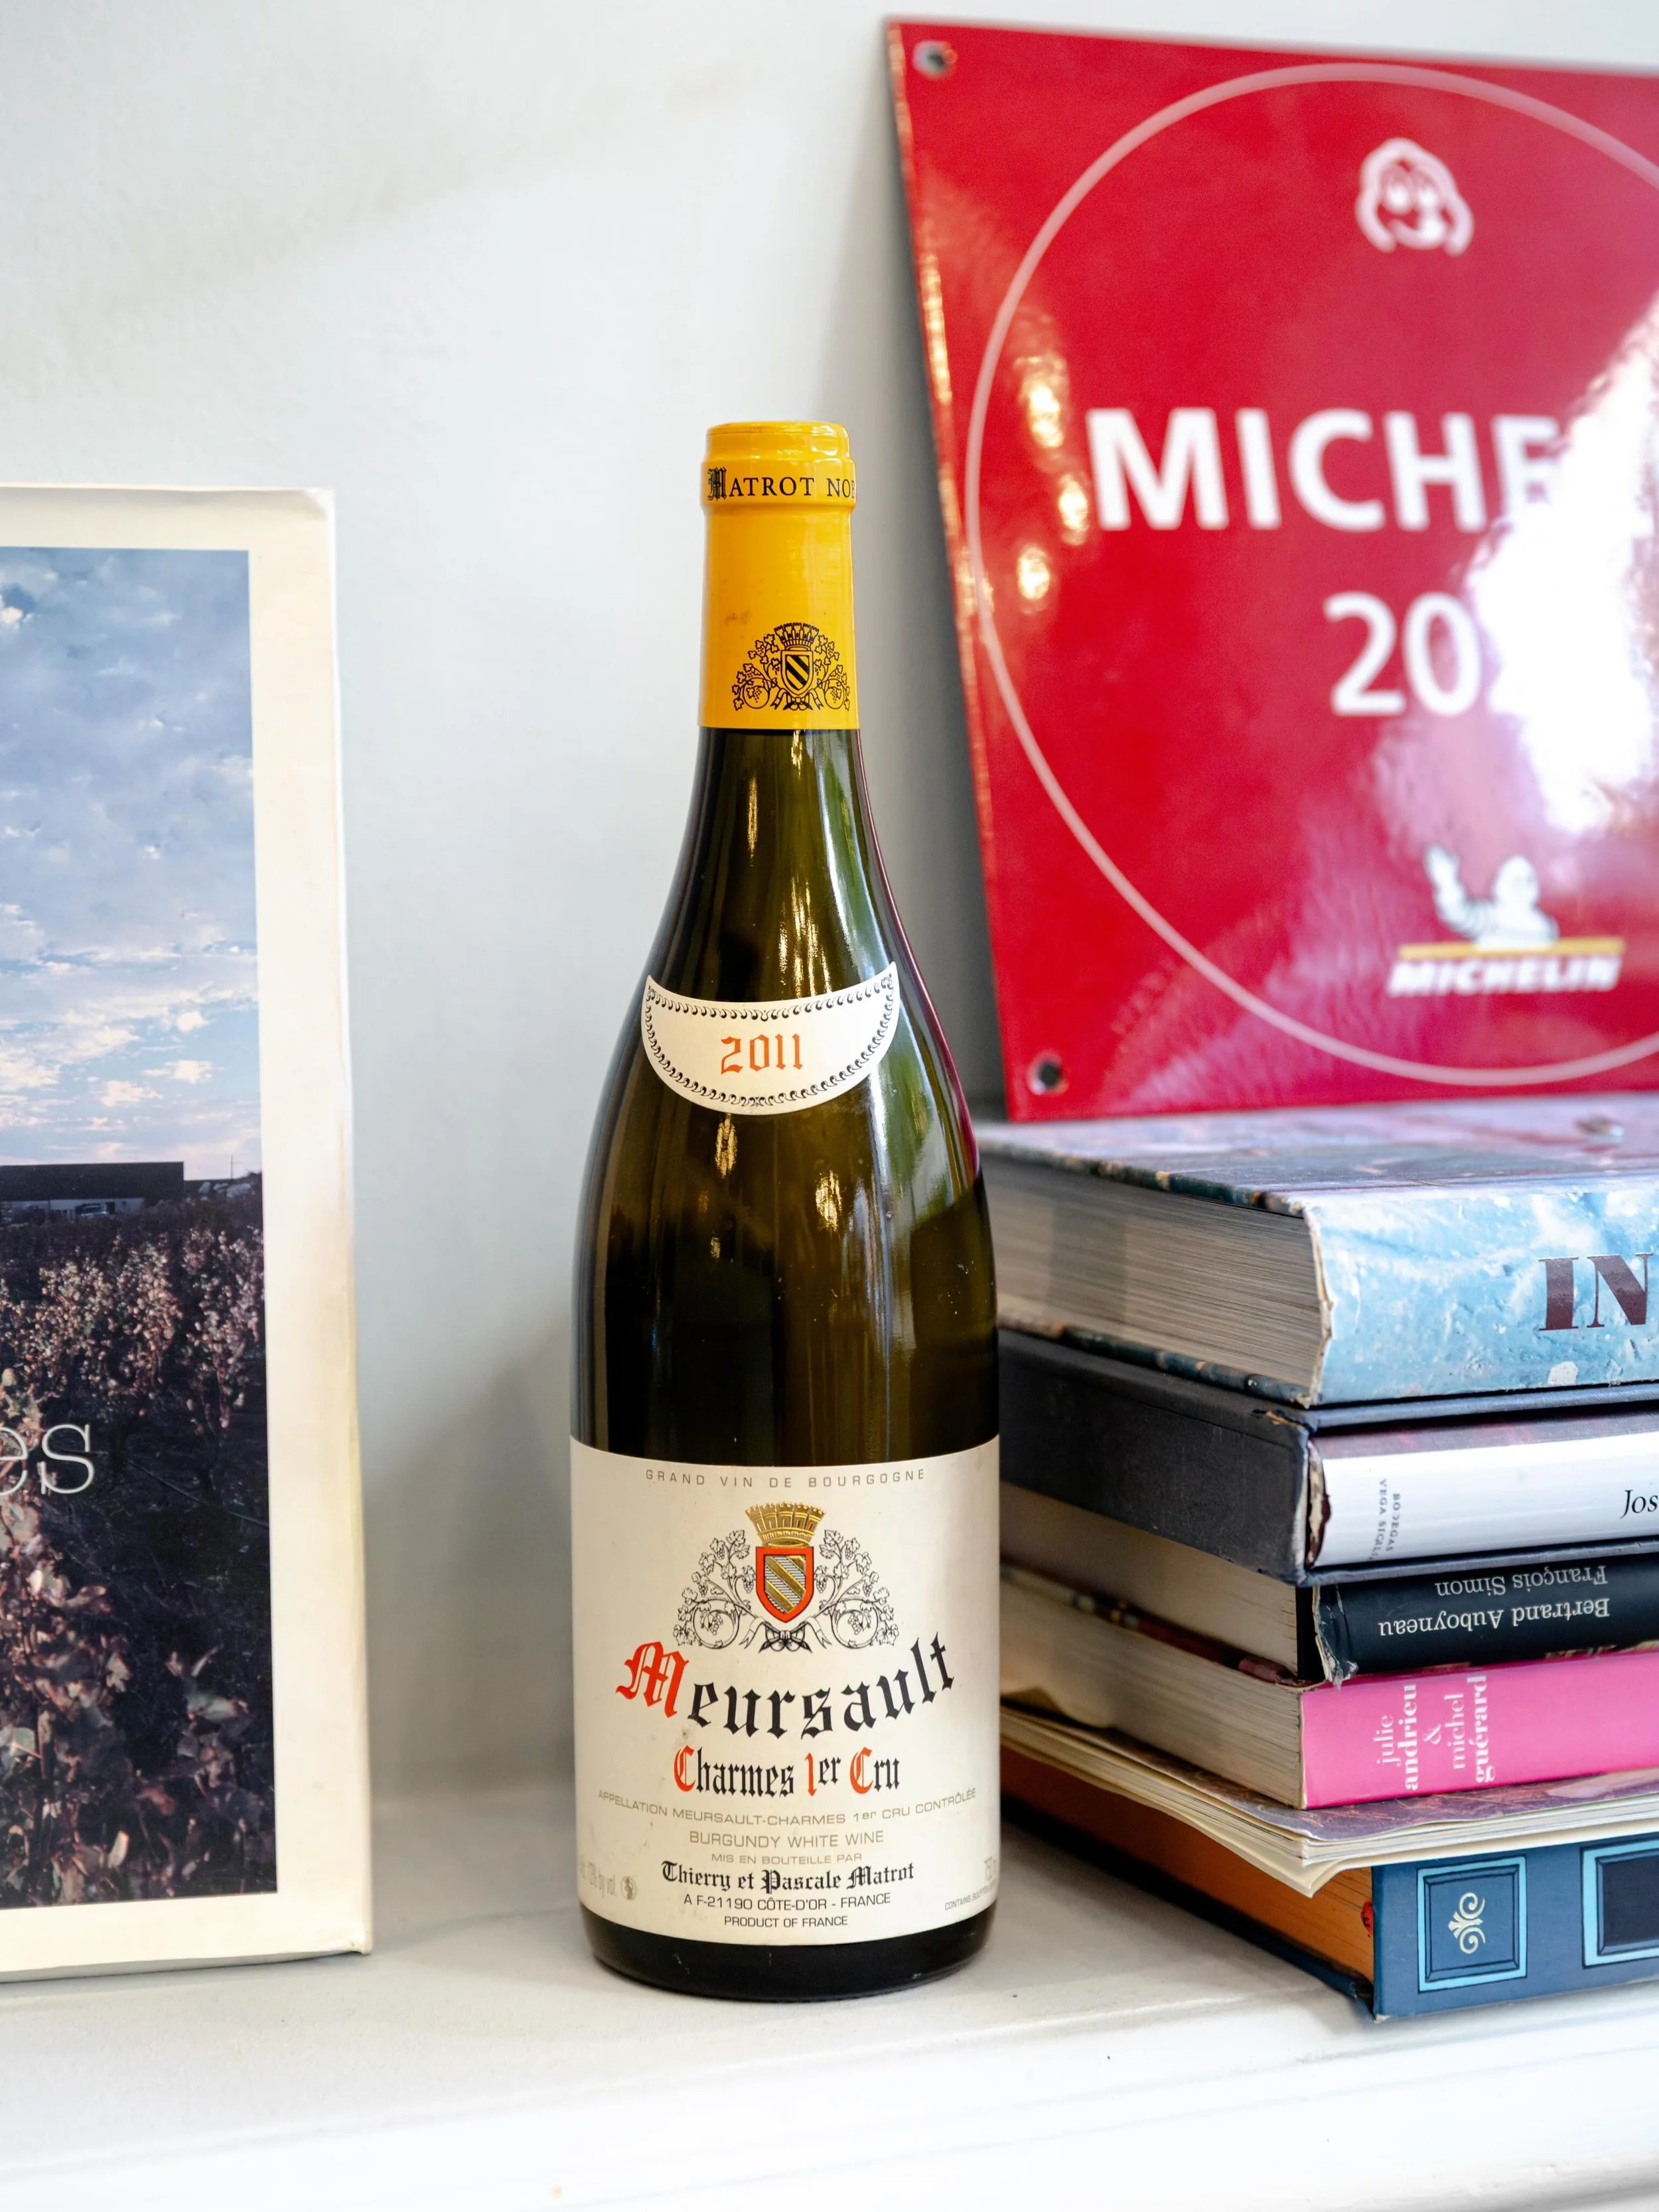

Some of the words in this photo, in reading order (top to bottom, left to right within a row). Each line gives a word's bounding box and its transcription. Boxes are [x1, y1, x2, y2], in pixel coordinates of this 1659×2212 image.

[707, 467, 814, 501] MATROT
[1086, 406, 1561, 531] MICHE
[1324, 591, 1482, 715] 20
[1389, 956, 1621, 996] MICHELIN
[721, 1033, 803, 1074] 2011
[1538, 1252, 1654, 1331] IN
[645, 1469, 705, 1485] GRAND
[721, 1477, 753, 1488] VIN
[769, 1477, 793, 1488] DE
[808, 1469, 926, 1488] BOURGOGNE
[1379, 1478, 1388, 1515] VEGA
[1619, 1489, 1658, 1520] Jos
[1435, 1576, 1506, 1596] Simon
[1513, 1566, 1609, 1593] François
[1378, 1609, 1504, 1637] Auboyneau
[1512, 1598, 1610, 1627] Bertrand
[615, 1631, 955, 1739] Meursault
[1374, 1714, 1402, 1765] julie
[1397, 1684, 1419, 1791] andrieu
[1423, 1725, 1442, 1744] &
[1444, 1693, 1465, 1770] michel
[1467, 1675, 1496, 1783] guérard
[674, 1745, 795, 1796] Charmes
[805, 1753, 842, 1797] 1er
[849, 1747, 901, 1795] Cru
[599, 1790, 668, 1816] APPELLATION
[672, 1808, 846, 1825] MEURSAULT-CHARMES
[853, 1811, 877, 1822] 1er
[882, 1806, 910, 1820] CRU
[915, 1788, 977, 1814] CONTRÔLÉE
[689, 1831, 781, 1848] BURGUNDY
[786, 1834, 839, 1848] WHITE
[845, 1830, 884, 1846] WINE
[711, 1854, 734, 1863] MIS
[762, 1855, 832, 1865] BOUTEILLE
[837, 1853, 862, 1862] PAR
[661, 1860, 731, 1891] Thierry
[738, 1872, 755, 1890] et
[760, 1869, 842, 1894] Pascale
[846, 1862, 914, 1889] Matrot
[684, 1893, 692, 1905] A
[697, 1895, 753, 1909] F-21190
[757, 1897, 828, 1911] CÔTE-D'OR
[841, 1892, 891, 1909] FRANCE
[724, 1916, 779, 1928] PRODUCT
[783, 1918, 798, 1928] OF
[802, 1915, 848, 1927] FRANCE
